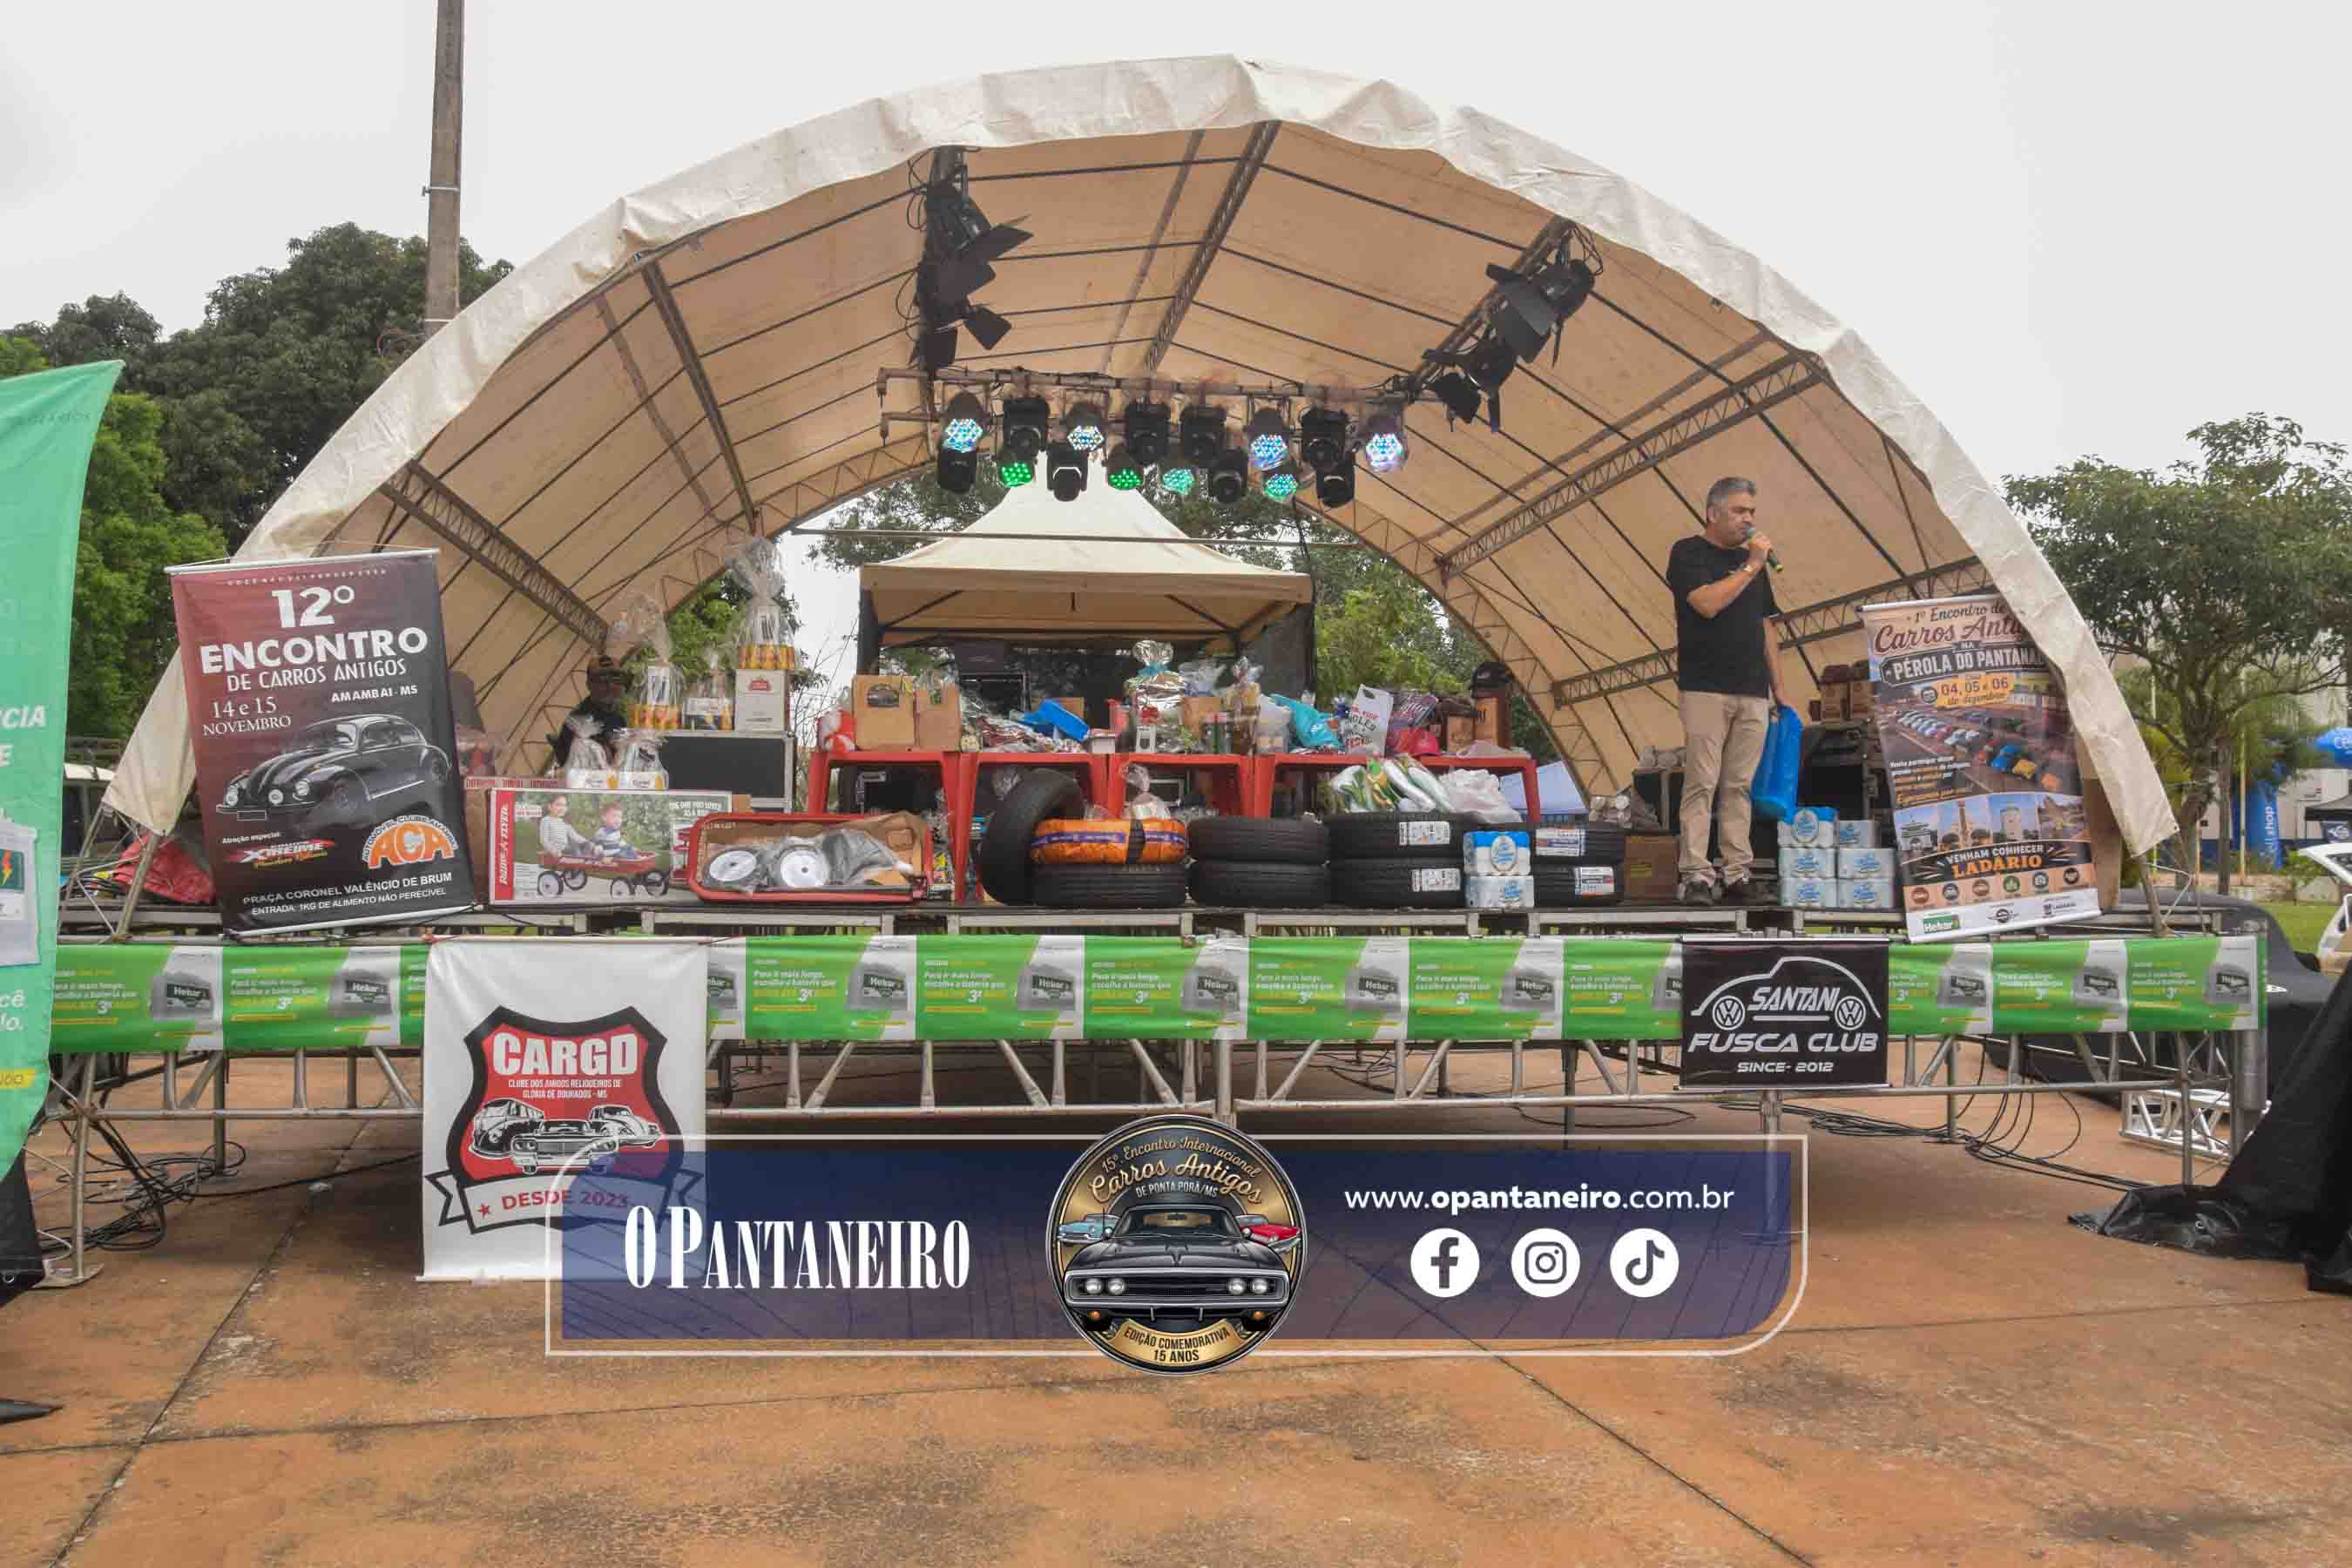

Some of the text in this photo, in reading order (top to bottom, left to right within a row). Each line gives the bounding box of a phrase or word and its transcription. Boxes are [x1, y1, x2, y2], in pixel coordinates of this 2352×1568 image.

[271, 585, 355, 628] 12º
[1930, 603, 1987, 622] Encontro
[1875, 624, 1956, 652] Carros
[199, 626, 429, 674] ENCONTRO
[227, 658, 406, 692] DE CARROS ANTIGOS
[1894, 654, 1952, 680] PÉROLA
[1957, 652, 1973, 671] DO
[1965, 680, 1980, 693] 05
[1992, 678, 2009, 691] 06
[0, 705, 47, 728] CIA
[212, 697, 277, 719] 14 e 15
[203, 715, 291, 736] NOVEMBRO
[368, 821, 455, 869] ACA
[1946, 844, 2045, 866] VENHAM CONHECER
[243, 871, 453, 905] PRAÇA CORONEL VALÊNCIO DE BRUM
[300, 901, 317, 911] 1KG
[318, 900, 332, 909] DE
[333, 895, 377, 908] ALIMENTO
[378, 891, 397, 902] NÃO
[398, 887, 447, 900] PERECÍVEL
[1687, 1033, 1879, 1052] FUSCA CLUB
[492, 1031, 639, 1077] CARGD
[1795, 1062, 1834, 1073] 2012
[508, 1078, 529, 1088] CLUBE
[530, 1078, 544, 1088] DOS
[544, 1078, 570, 1088] AMIGOS
[612, 1078, 621, 1087] DE
[547, 1089, 556, 1098] DE
[557, 1089, 591, 1098] DOURADOS
[597, 1089, 607, 1098] MS
[501, 1188, 572, 1210] DESDE
